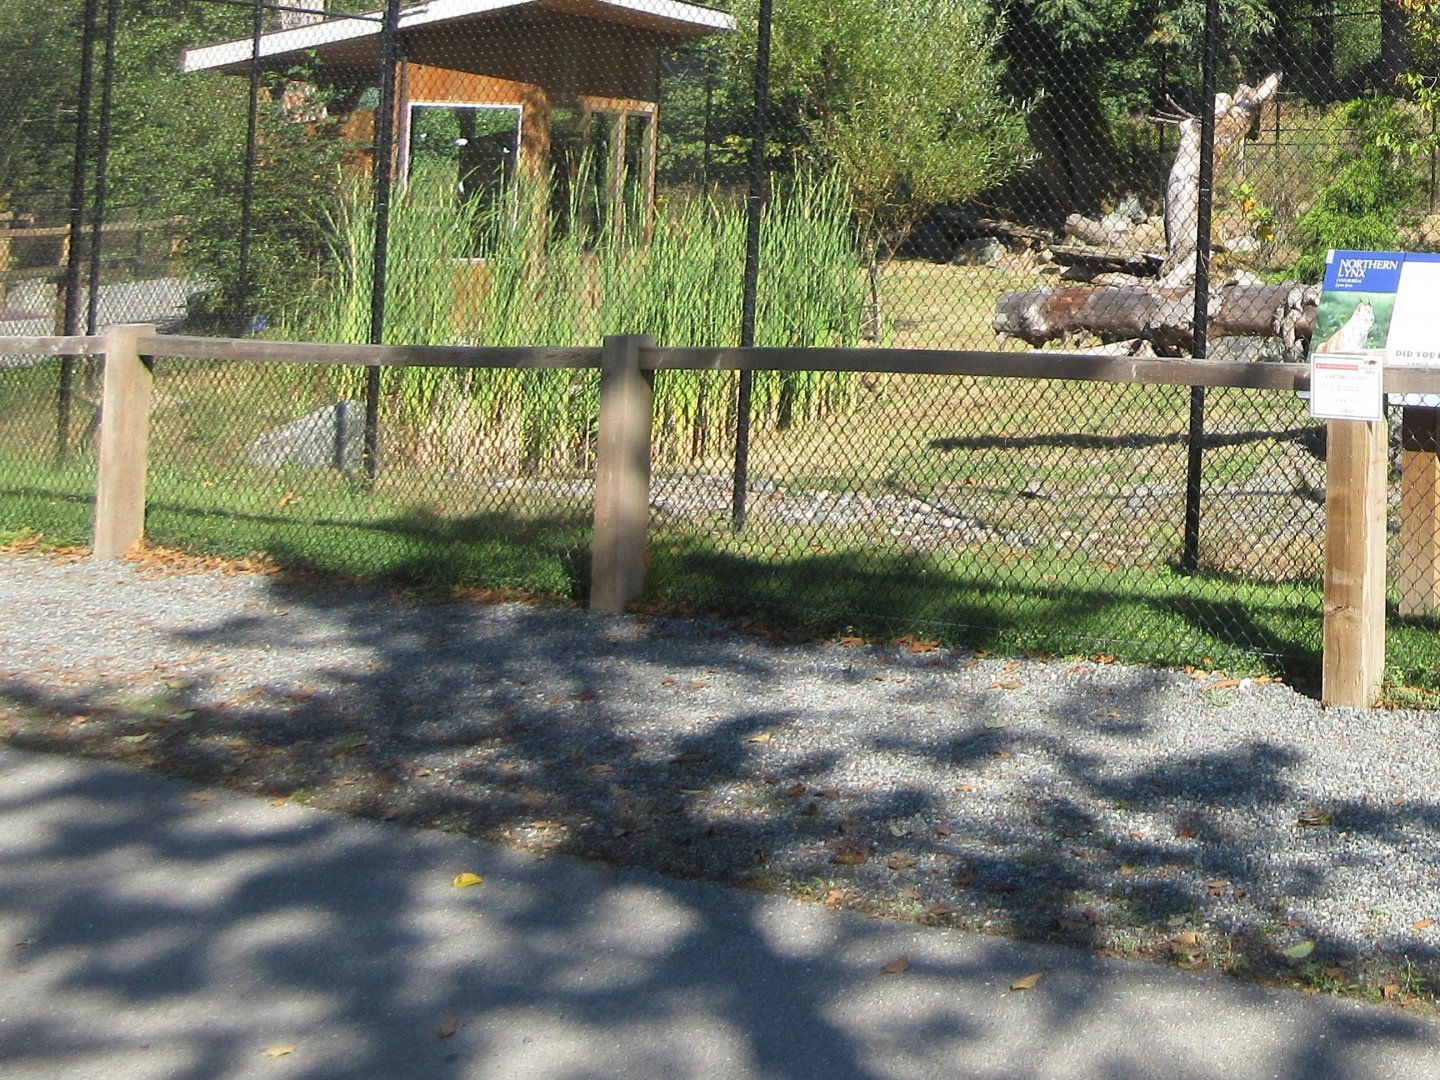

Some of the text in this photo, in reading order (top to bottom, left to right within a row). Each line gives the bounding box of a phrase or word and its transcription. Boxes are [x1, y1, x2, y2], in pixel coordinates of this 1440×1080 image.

[1339, 258, 1399, 270] NORTHERN
[1337, 267, 1367, 278] LYNX
[1395, 349, 1413, 357] DID
[1416, 351, 1436, 359] YOU
